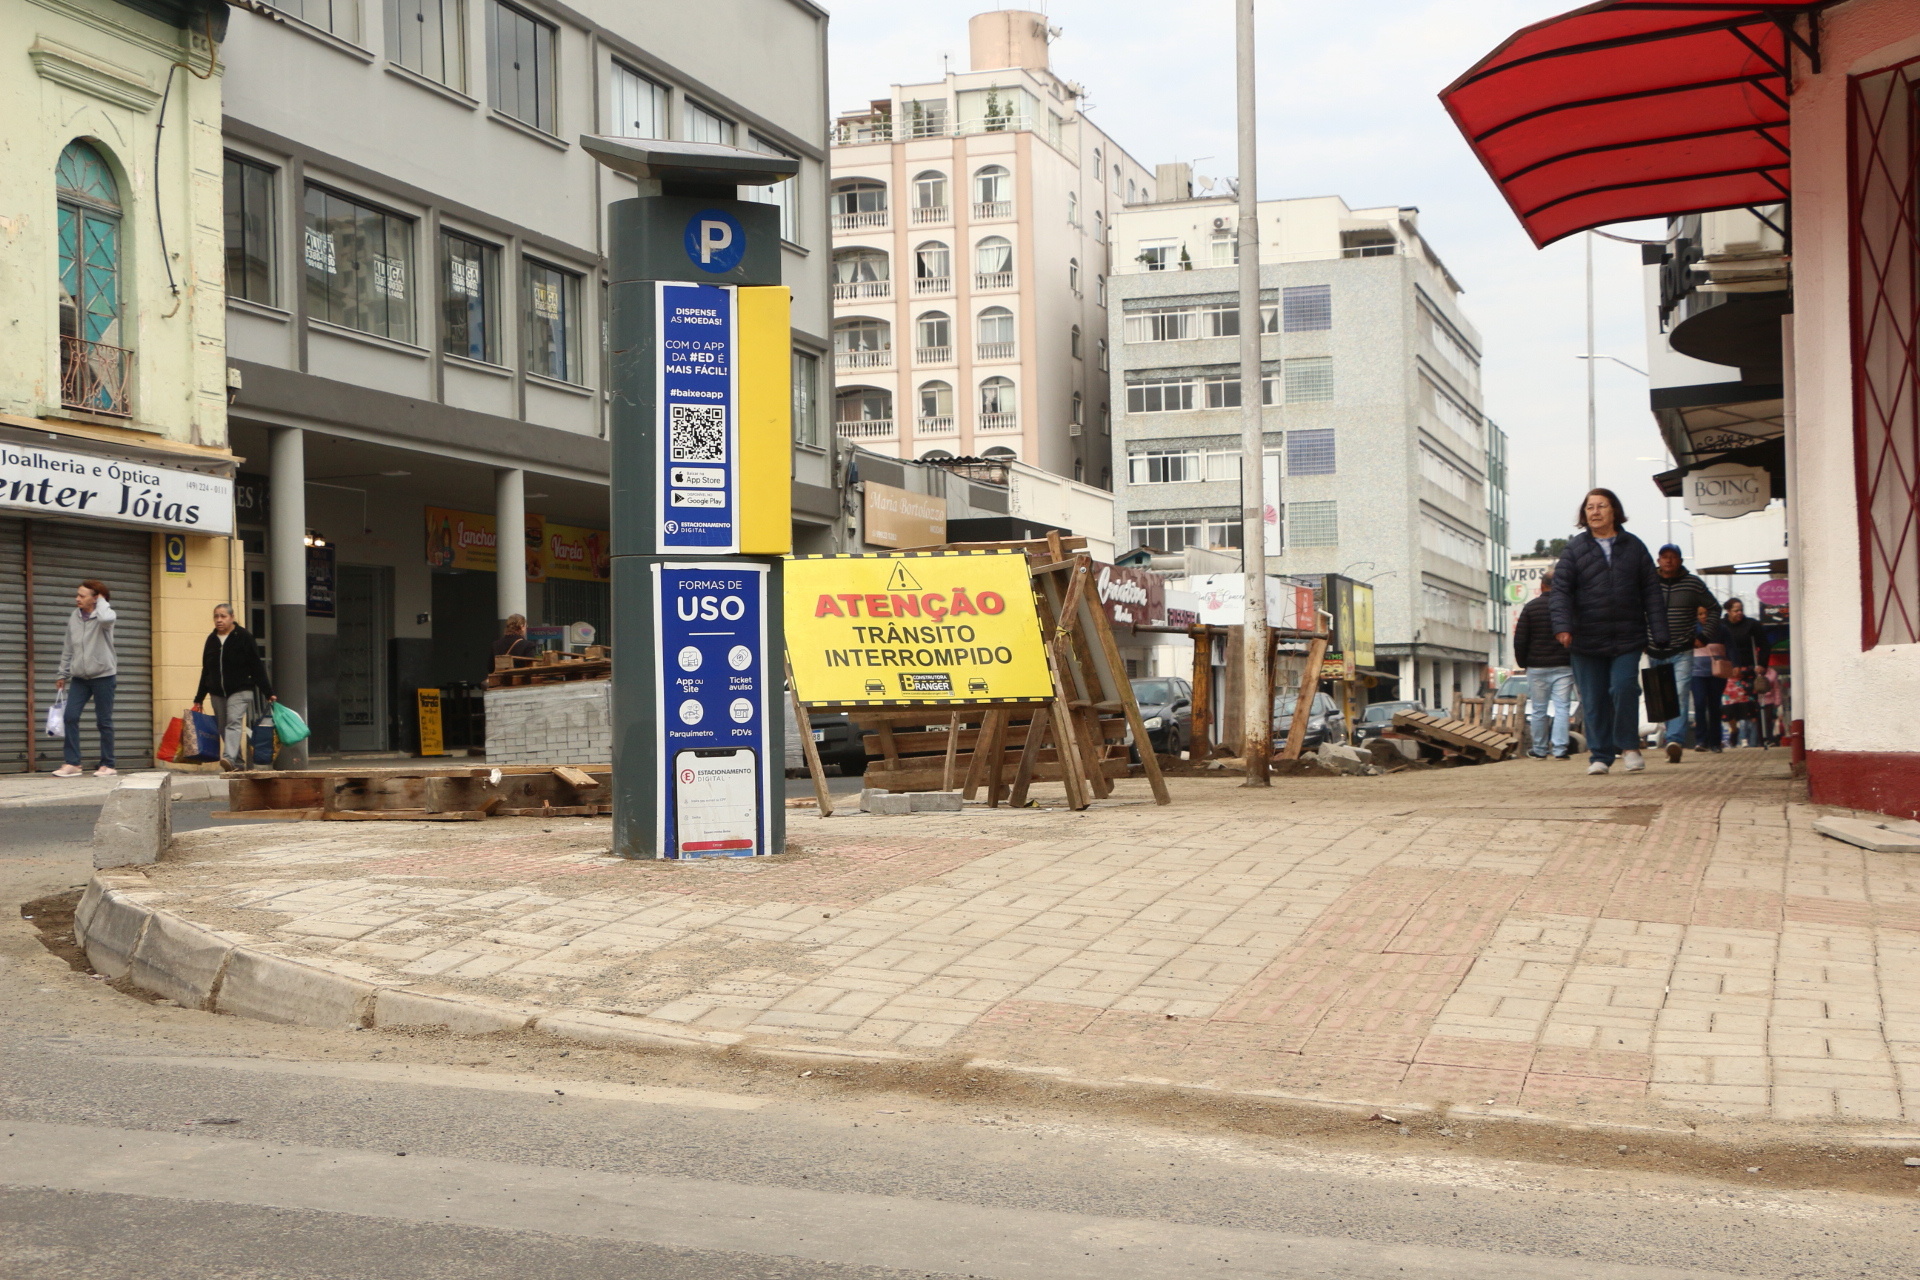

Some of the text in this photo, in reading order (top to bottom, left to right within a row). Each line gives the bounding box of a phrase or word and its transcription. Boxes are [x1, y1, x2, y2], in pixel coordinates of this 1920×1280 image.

[700, 219, 733, 264] P
[374, 262, 404, 284] ALUGA
[452, 262, 479, 284] ALUGA
[676, 307, 717, 317] DISPENSE
[670, 316, 722, 326] AS MOEDAS!
[665, 340, 724, 350] COM O APP
[672, 352, 725, 364] DA #ED É
[666, 364, 728, 376] MAIS FÁCIL!
[670, 389, 724, 400] #baixeoapp
[2, 450, 160, 486] Joalheria e Óptica
[1695, 478, 1759, 496] BOING
[118, 482, 200, 524] Jóias
[236, 486, 254, 508] ES
[687, 497, 709, 505] Google
[870, 492, 898, 512] Maria
[1718, 498, 1752, 506] MODAS
[678, 580, 742, 590] FORMAS DE
[677, 595, 745, 622] USO
[814, 587, 1006, 622] ATENÇÃO
[852, 622, 976, 644] TRÂNSITO
[825, 646, 1012, 667] INTERROMPIDO
[676, 678, 694, 687] App
[684, 684, 700, 693] Site
[670, 730, 714, 739] Parquímetro
